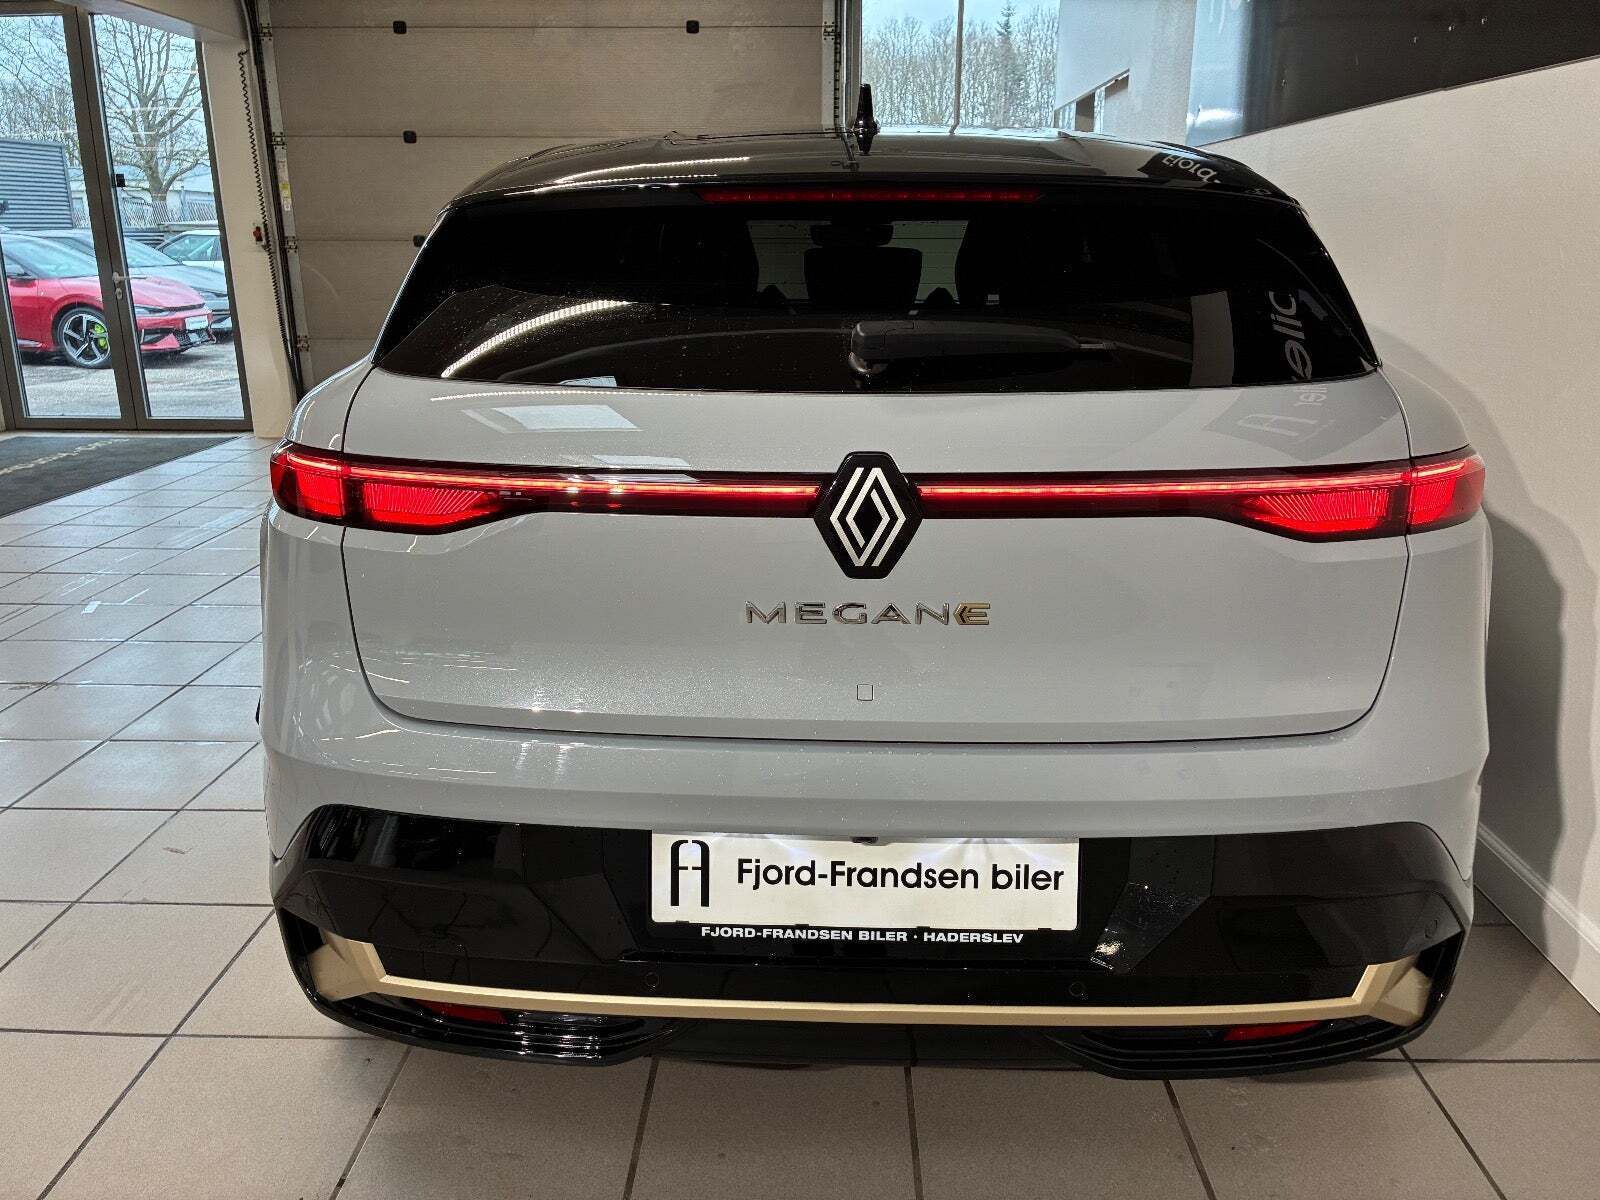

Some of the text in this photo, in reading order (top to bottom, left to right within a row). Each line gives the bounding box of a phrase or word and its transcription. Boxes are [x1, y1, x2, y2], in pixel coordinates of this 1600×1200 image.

[745, 600, 991, 626] MEGANE
[737, 858, 1065, 891] Fjord-Frandsen biler
[701, 926, 1024, 944] FJORD-FRANDSEN BILER HADERSLEV
